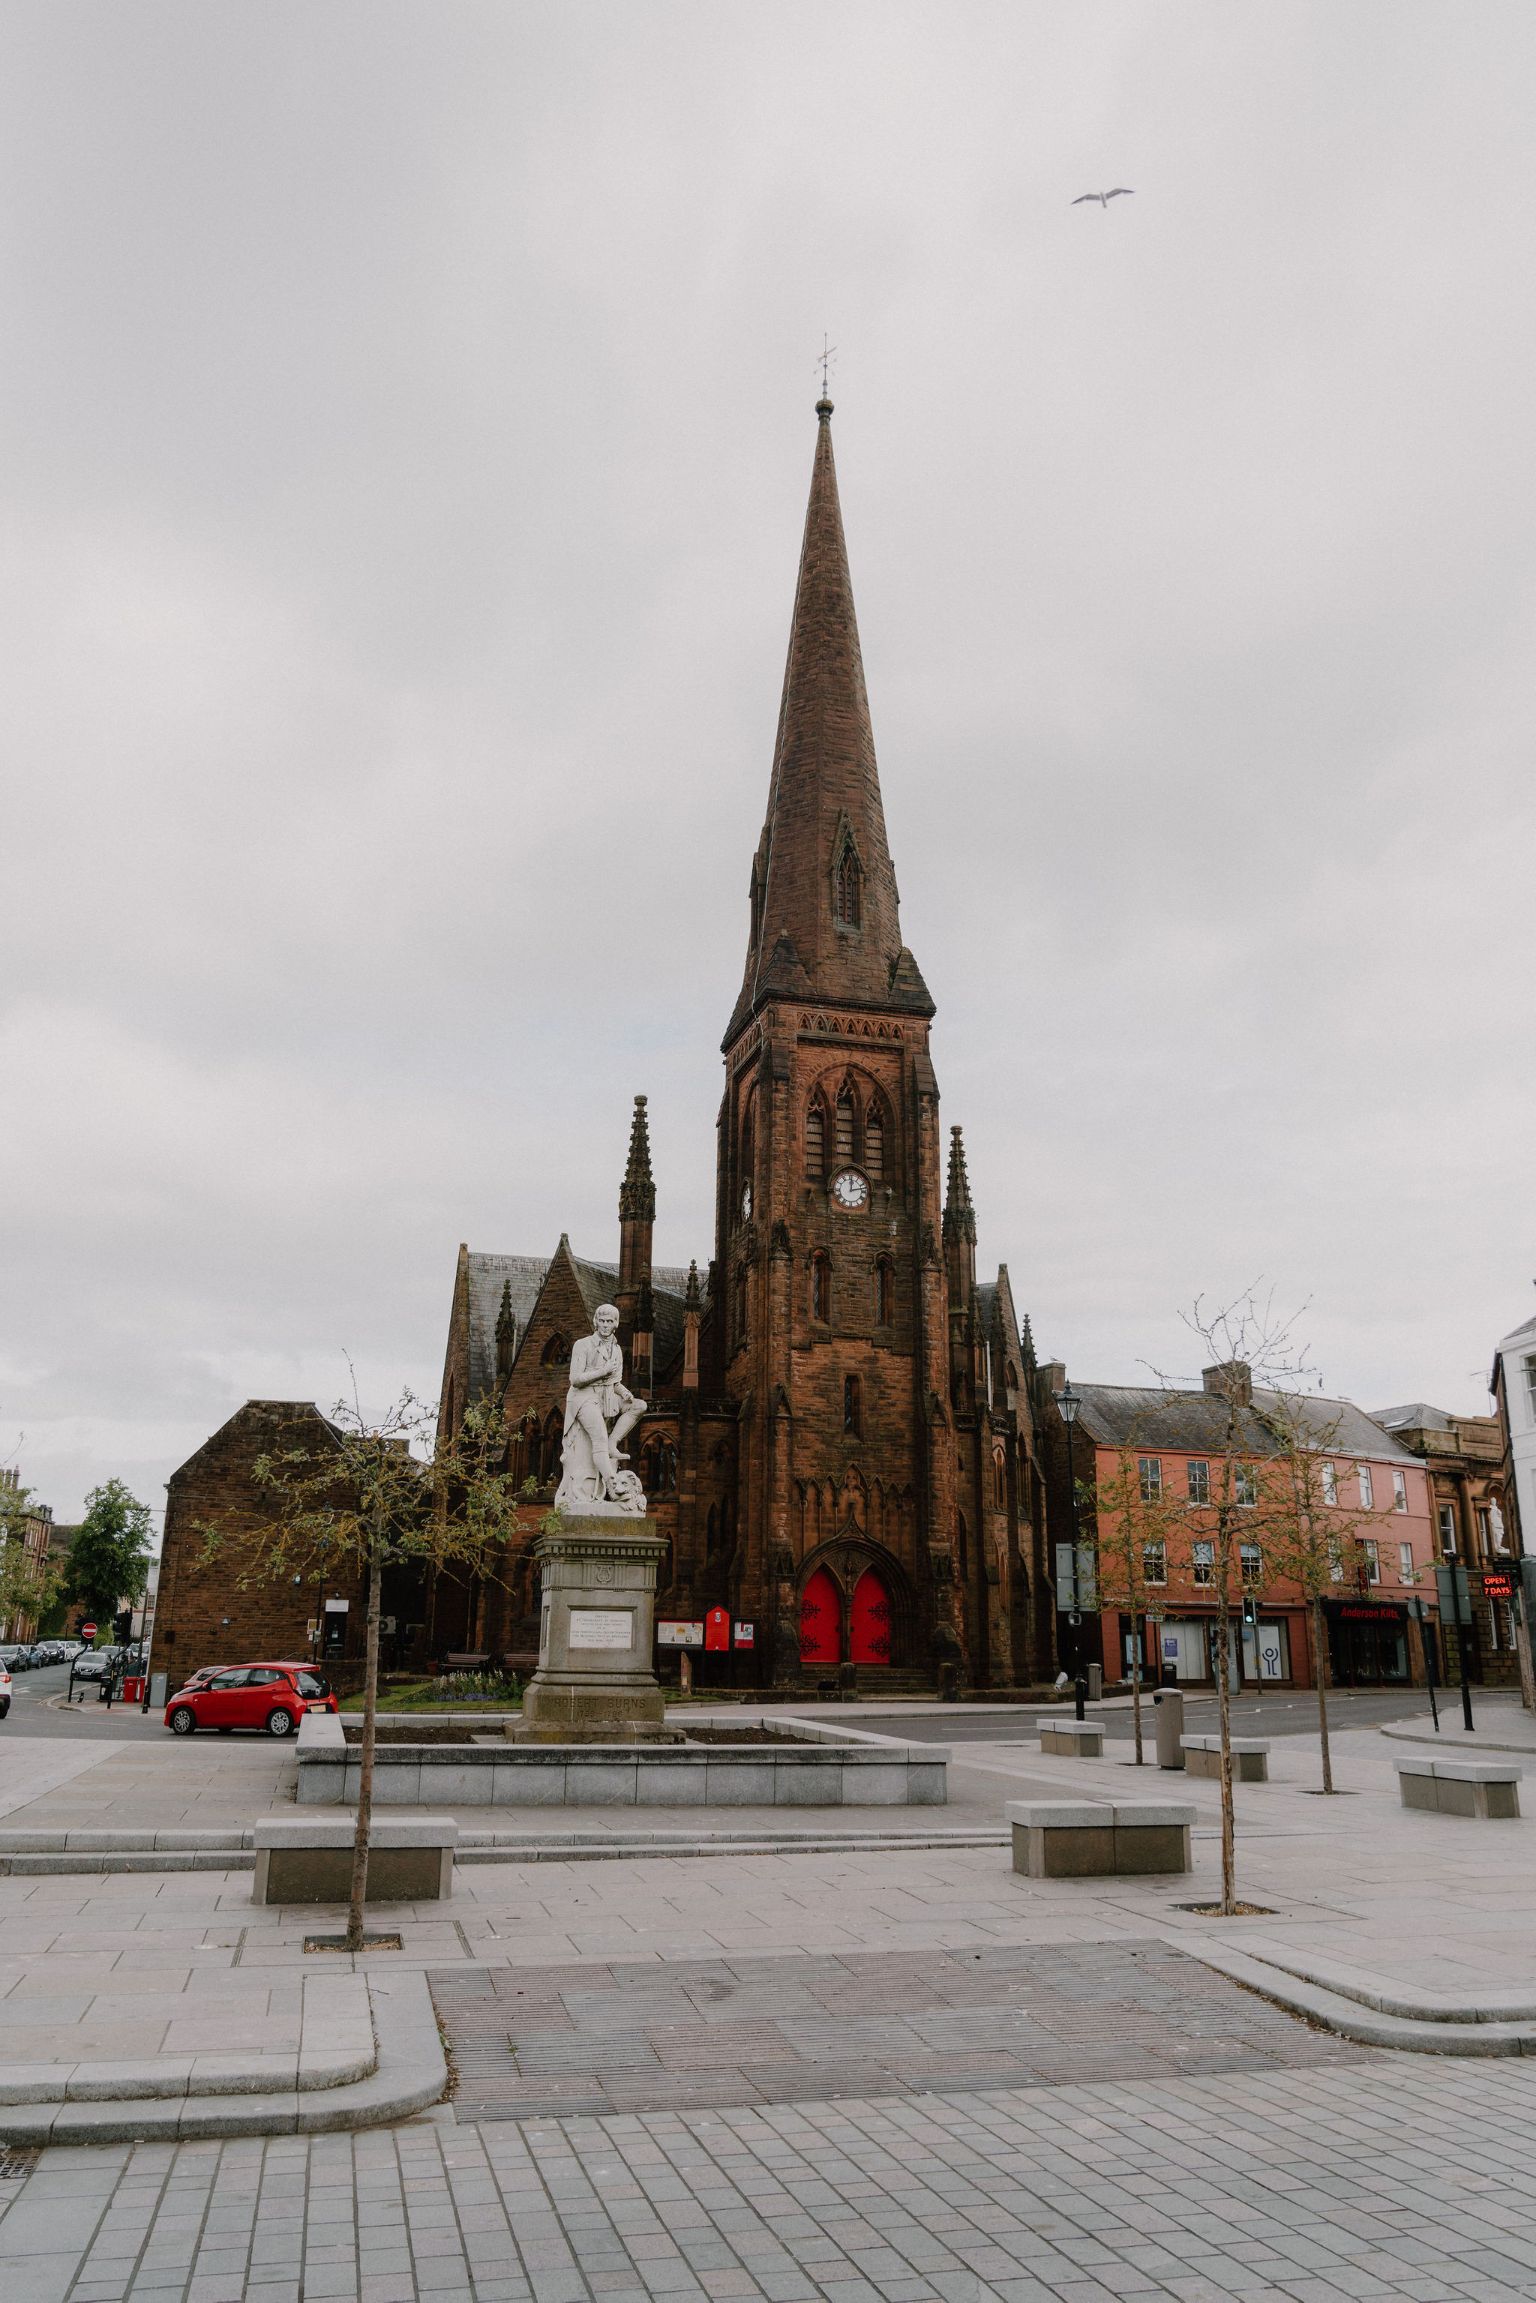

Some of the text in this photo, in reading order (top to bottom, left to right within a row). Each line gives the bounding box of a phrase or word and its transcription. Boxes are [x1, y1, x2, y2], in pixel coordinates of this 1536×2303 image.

[1484, 1577, 1506, 1585] OPEN
[1484, 1586, 1510, 1595] 7 DAYS
[1340, 1606, 1399, 1619] Anderson Kilts
[553, 1697, 646, 1709] ROBERT BURNS
